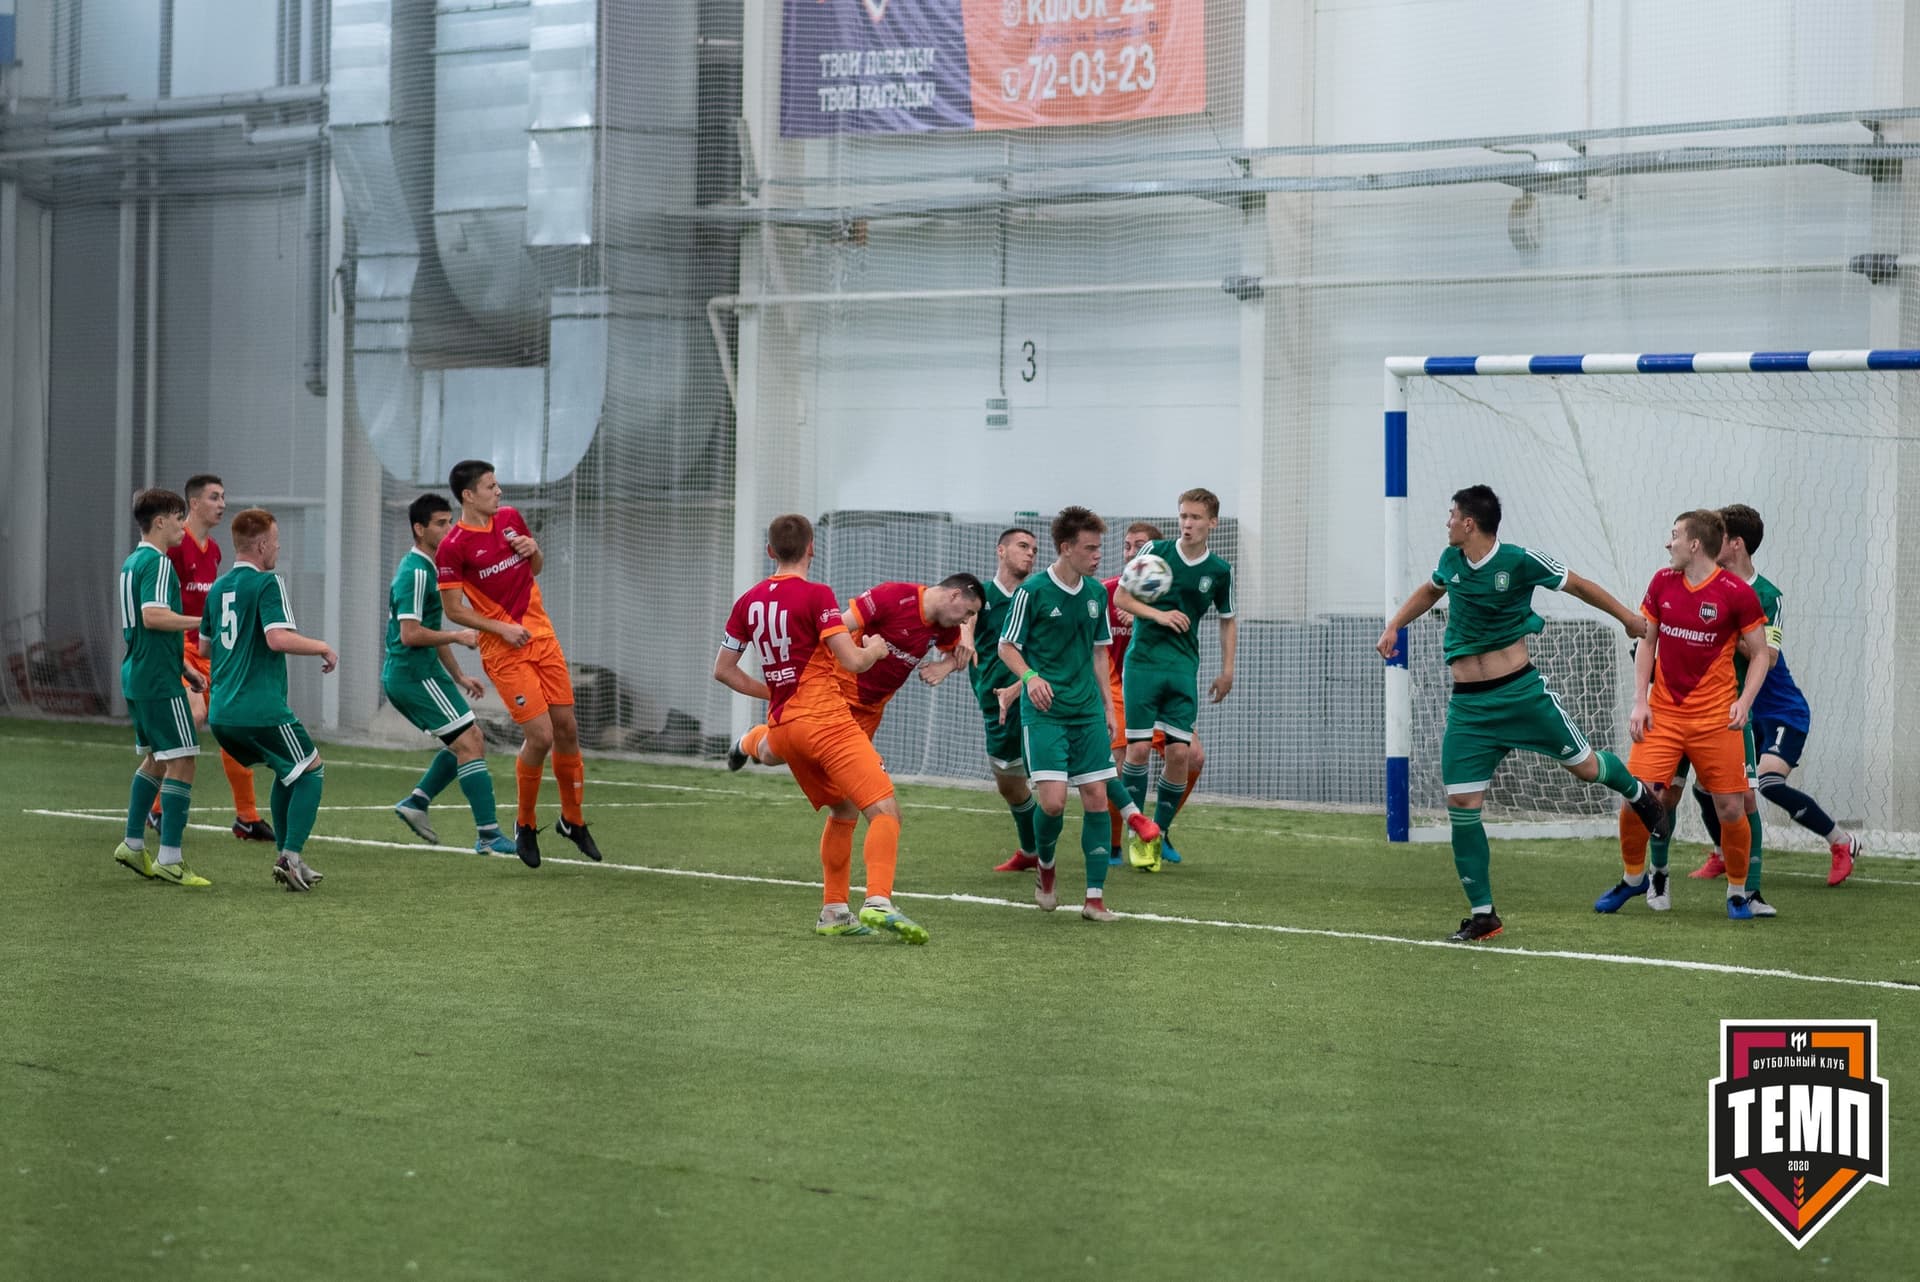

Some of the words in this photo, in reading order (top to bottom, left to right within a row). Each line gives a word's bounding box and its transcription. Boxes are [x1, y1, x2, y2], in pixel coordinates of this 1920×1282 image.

[819, 52, 861, 77] ТВОИ
[1027, 42, 1157, 101] 72-03-23
[818, 86, 858, 112] ТВОИ
[1022, 340, 1036, 382] 3
[119, 569, 136, 629] 11
[220, 591, 238, 650] 5
[748, 601, 792, 666] 24
[1775, 726, 1786, 746] 1
